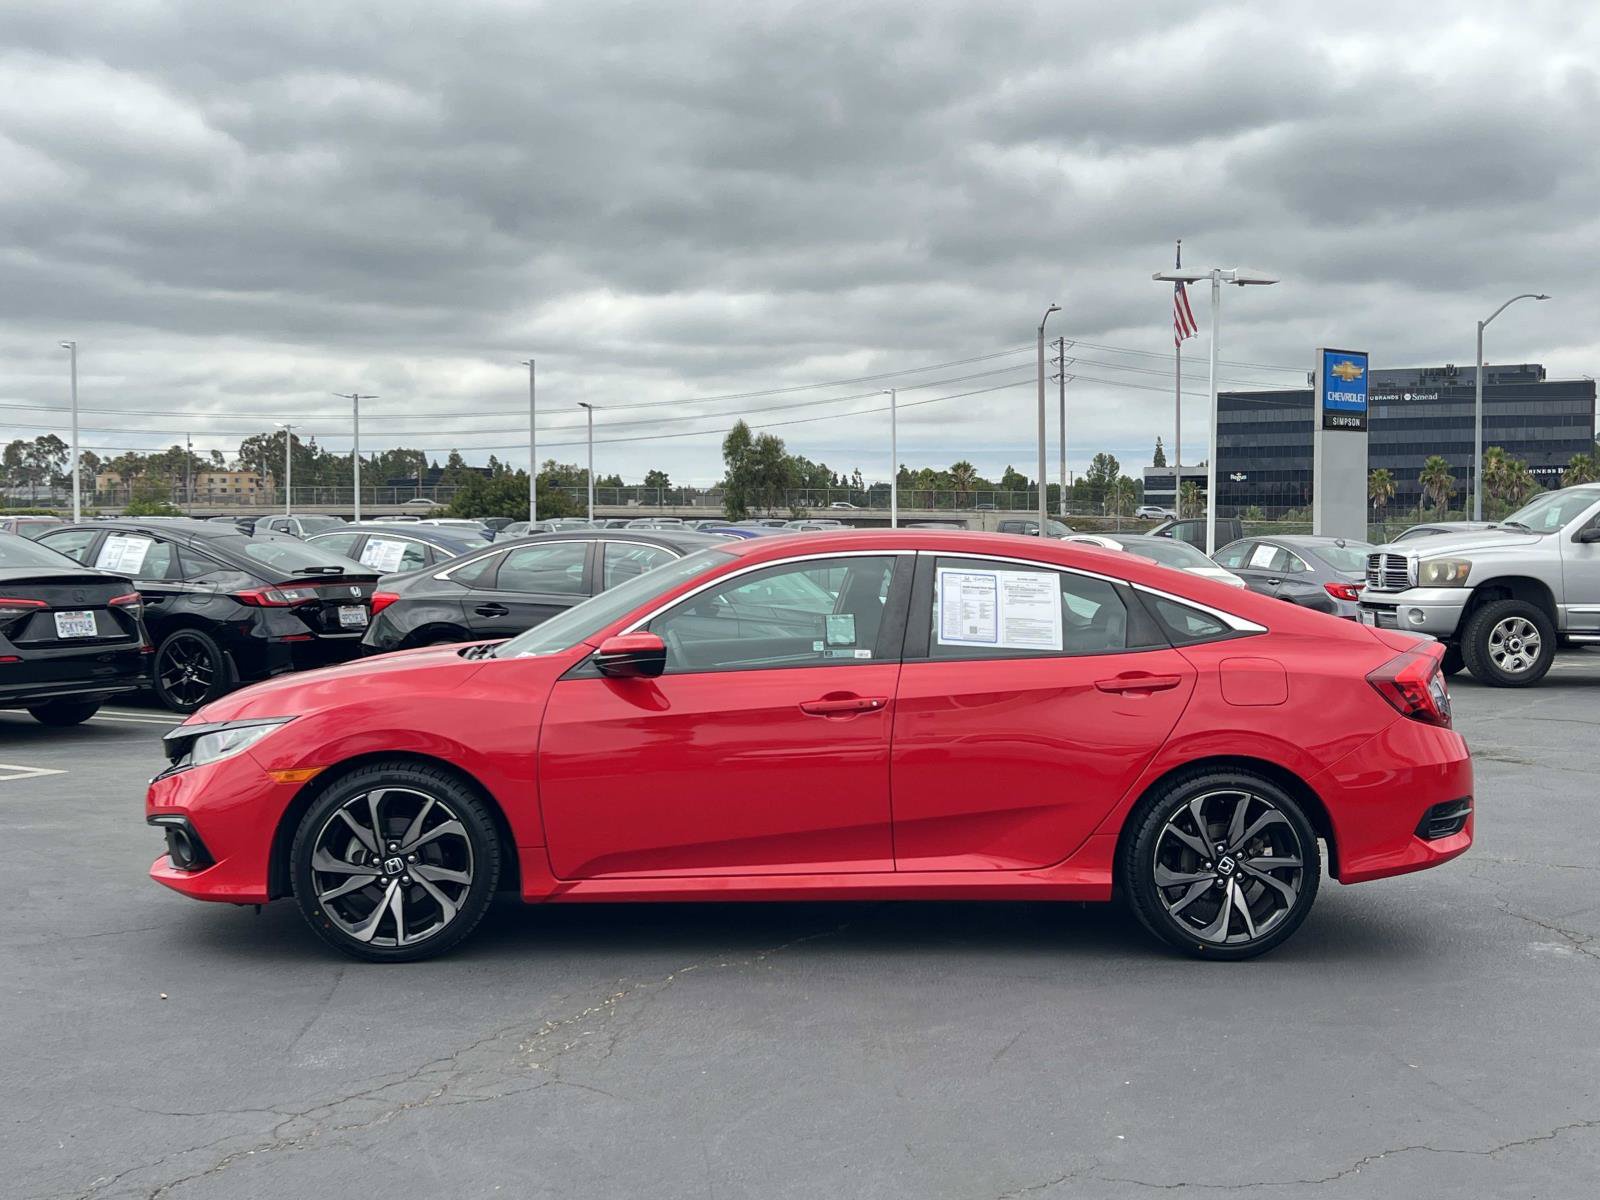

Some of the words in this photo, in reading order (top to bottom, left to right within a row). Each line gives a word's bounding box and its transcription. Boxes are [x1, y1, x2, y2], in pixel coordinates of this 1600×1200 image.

[1327, 391, 1365, 403] CHEVROLET
[1411, 392, 1438, 401] Smead
[1332, 416, 1361, 427] SIMPSON
